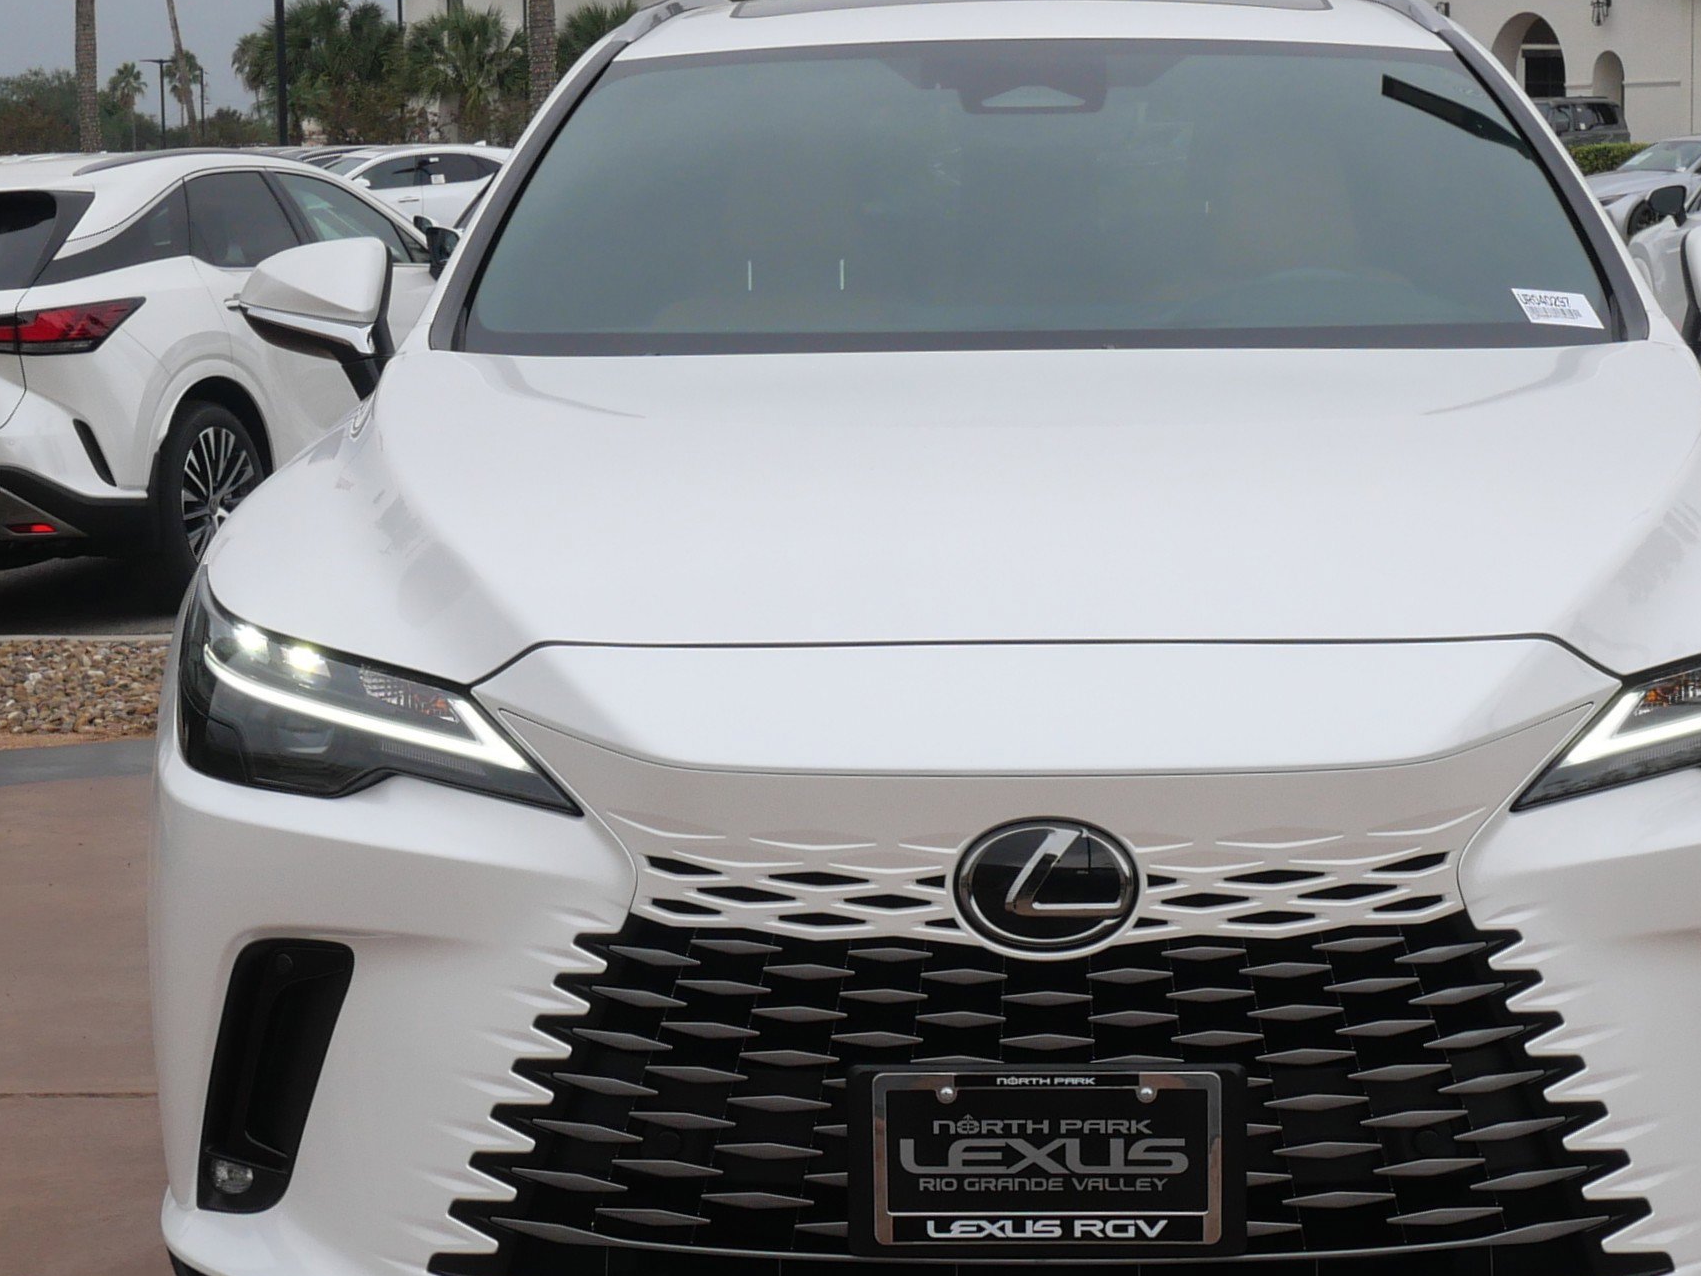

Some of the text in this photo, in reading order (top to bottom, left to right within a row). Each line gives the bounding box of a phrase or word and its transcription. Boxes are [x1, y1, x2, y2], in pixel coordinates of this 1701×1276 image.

[996, 1077, 1096, 1085] NORTH PARK
[933, 1118, 1153, 1134] NORTH PARK
[899, 1138, 1189, 1174] LEXUS
[919, 1178, 1168, 1191] RIO GRANDE VALLEY
[926, 1220, 1168, 1238] LEXUS RGV
